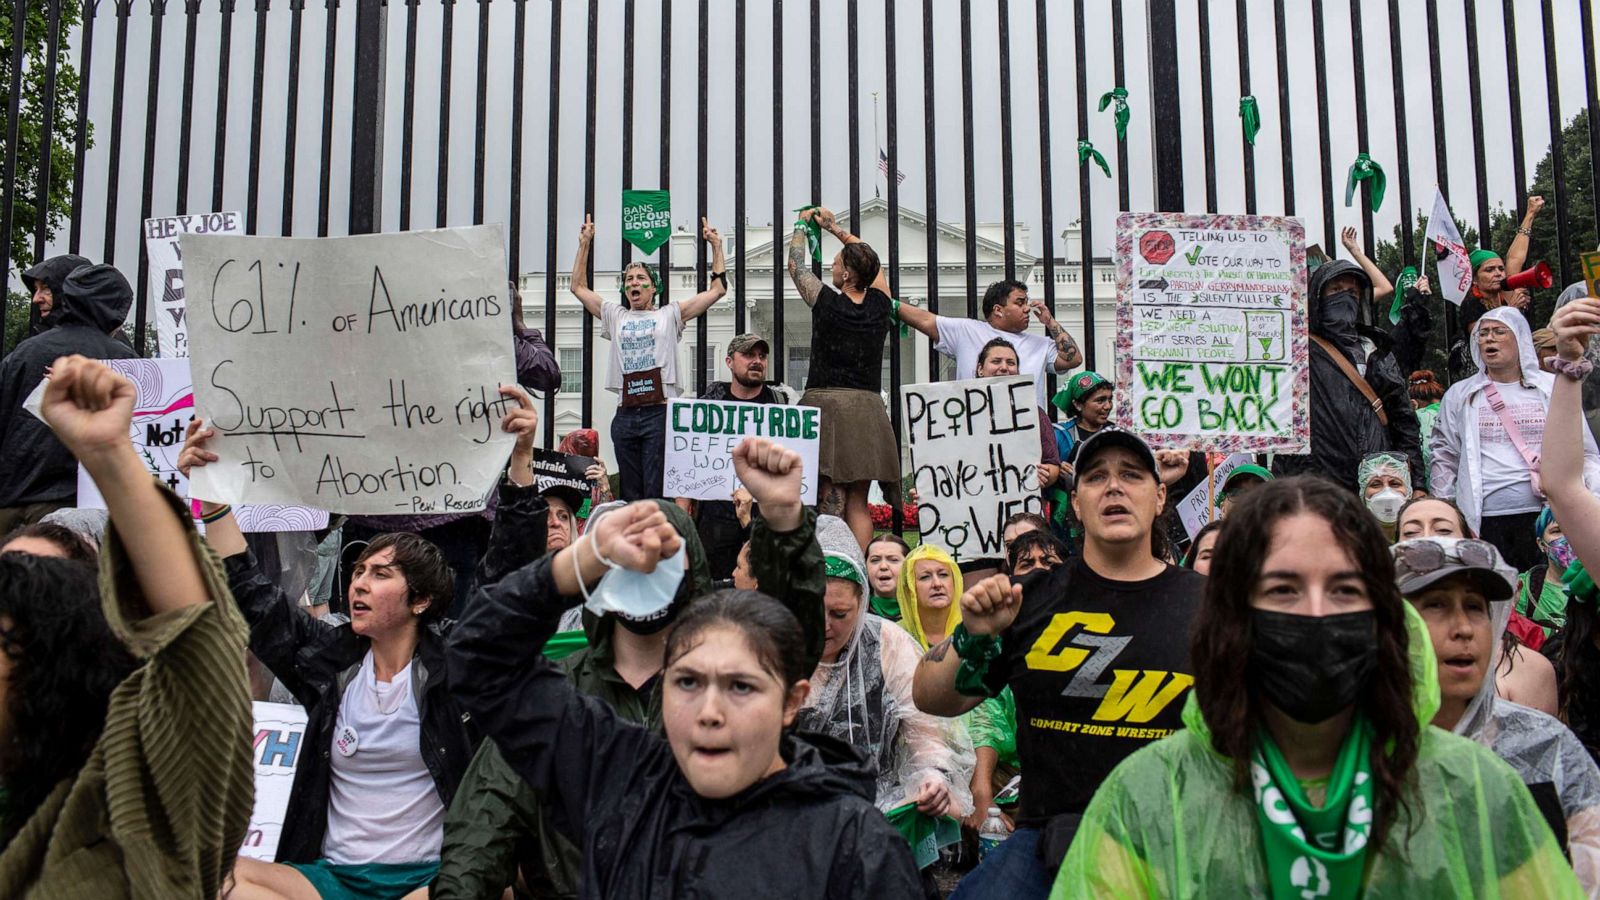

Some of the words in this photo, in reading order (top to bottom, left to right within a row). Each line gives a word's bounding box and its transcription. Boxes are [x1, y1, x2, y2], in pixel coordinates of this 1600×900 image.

[624, 204, 653, 215] BANS
[624, 213, 646, 223] OFF
[646, 211, 671, 221] OUR
[147, 216, 192, 239] HEY
[195, 212, 236, 233] JOE
[625, 220, 668, 230] BODIES
[1180, 231, 1224, 243] TELLING
[1228, 233, 1246, 242] US
[1250, 233, 1267, 243] TO
[1223, 256, 1243, 267] OUR
[1246, 257, 1263, 268] WAY
[1266, 258, 1281, 268] TO
[1171, 281, 1204, 291] PARTISAN
[211, 259, 307, 335] 61%
[332, 314, 357, 332] OF
[368, 265, 501, 334] Americans
[1143, 293, 1156, 302] IS
[1165, 293, 1182, 302] THE
[1199, 294, 1233, 303] SILENT
[1236, 295, 1273, 304] KILLER
[1141, 308, 1162, 320] WE
[1169, 310, 1197, 321] NEED
[1202, 310, 1212, 321] A
[1198, 323, 1243, 334] SOLUTION
[1140, 333, 1167, 344] THAT
[1171, 335, 1207, 346] SERVES
[1212, 336, 1231, 345] ALL
[1140, 346, 1193, 358] PREGNANT
[1197, 347, 1236, 359] PEOPLE
[631, 379, 644, 387] had
[1137, 362, 1194, 392] WE
[627, 385, 655, 395] abortion.
[211, 359, 356, 453] Support
[382, 378, 443, 430] the
[455, 382, 520, 444] right
[1141, 395, 1183, 430] GO
[1197, 395, 1280, 432] BACK
[672, 403, 764, 436] CODIFY
[768, 407, 819, 440] ROE
[146, 419, 184, 447] Not
[673, 436, 738, 454] DEFE
[241, 446, 276, 482] to
[316, 454, 462, 498] Abortion.
[531, 460, 568, 474] nafraid.
[909, 447, 984, 500] have
[983, 443, 1042, 496] the
[1190, 488, 1208, 512] PRO
[1025, 611, 1195, 723] CZW
[1030, 717, 1081, 733] COMBAT
[1080, 725, 1115, 737] ZONE
